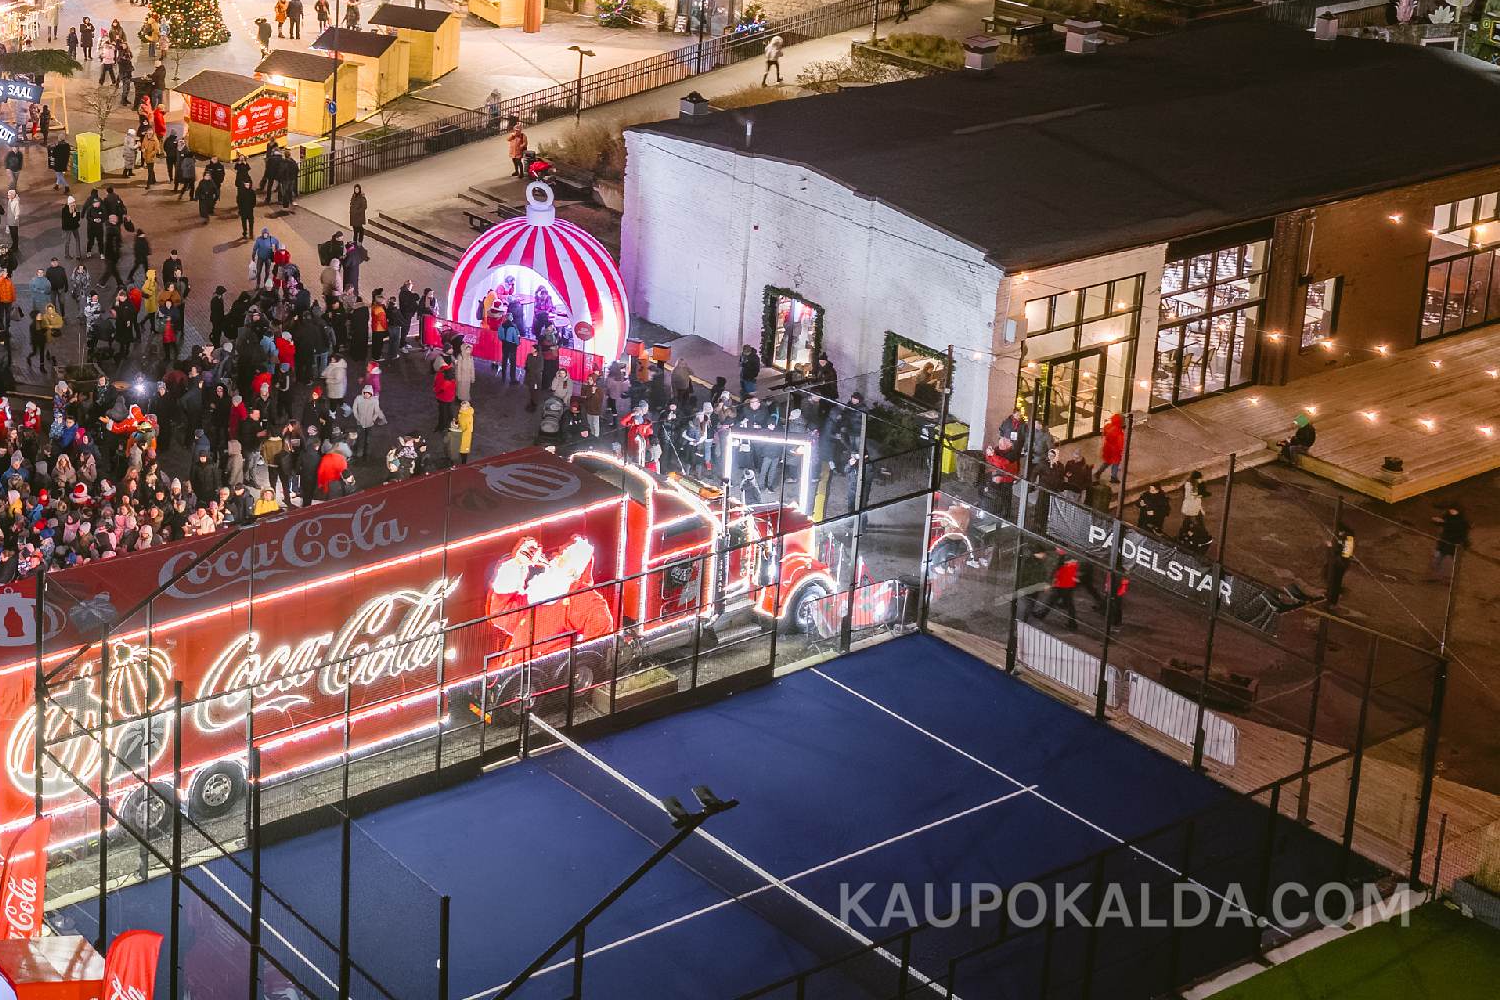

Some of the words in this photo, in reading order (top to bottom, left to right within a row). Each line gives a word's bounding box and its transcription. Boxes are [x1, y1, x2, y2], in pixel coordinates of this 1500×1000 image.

[158, 499, 409, 600] Coca-Cola
[1088, 524, 1234, 606] PADELSTAR
[194, 572, 464, 733] Coca-Cola
